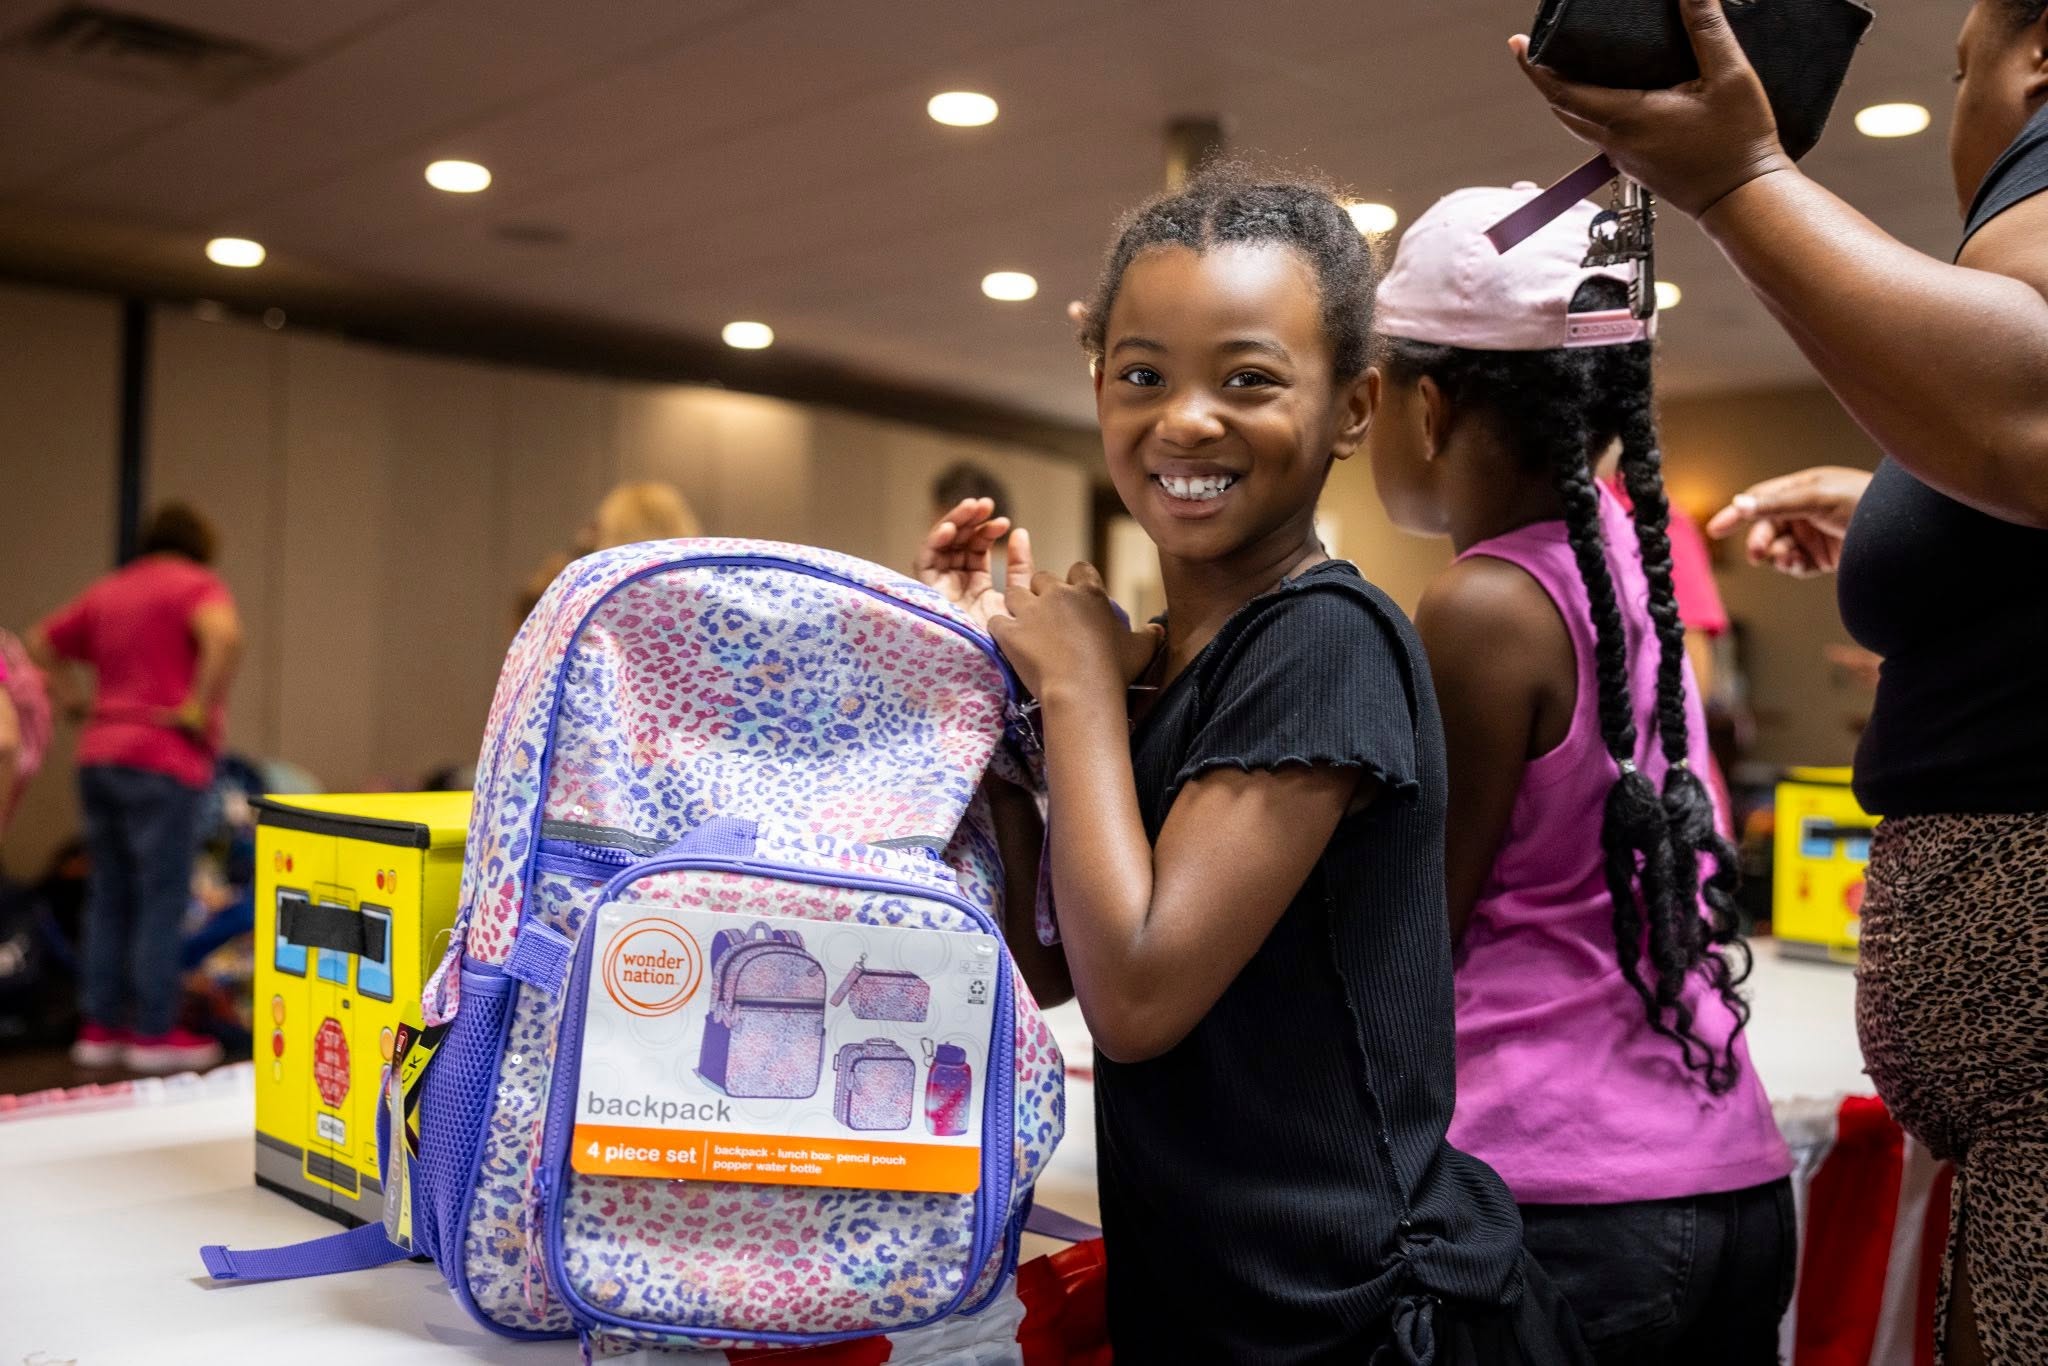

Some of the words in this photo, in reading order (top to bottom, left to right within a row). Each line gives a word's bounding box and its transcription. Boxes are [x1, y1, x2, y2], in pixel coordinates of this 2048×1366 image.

[623, 949, 685, 969] wonder
[623, 968, 675, 985] nation
[587, 1090, 731, 1124] backpack
[586, 1141, 600, 1158] 4
[605, 1143, 660, 1164] piece
[666, 1146, 697, 1164] set
[714, 1145, 768, 1158] backpack
[778, 1148, 808, 1160] lunch
[837, 1152, 870, 1165] pencil
[872, 1154, 906, 1167] pouch
[713, 1159, 752, 1171] popper
[756, 1161, 786, 1173] water
[790, 1163, 822, 1174] bottle
